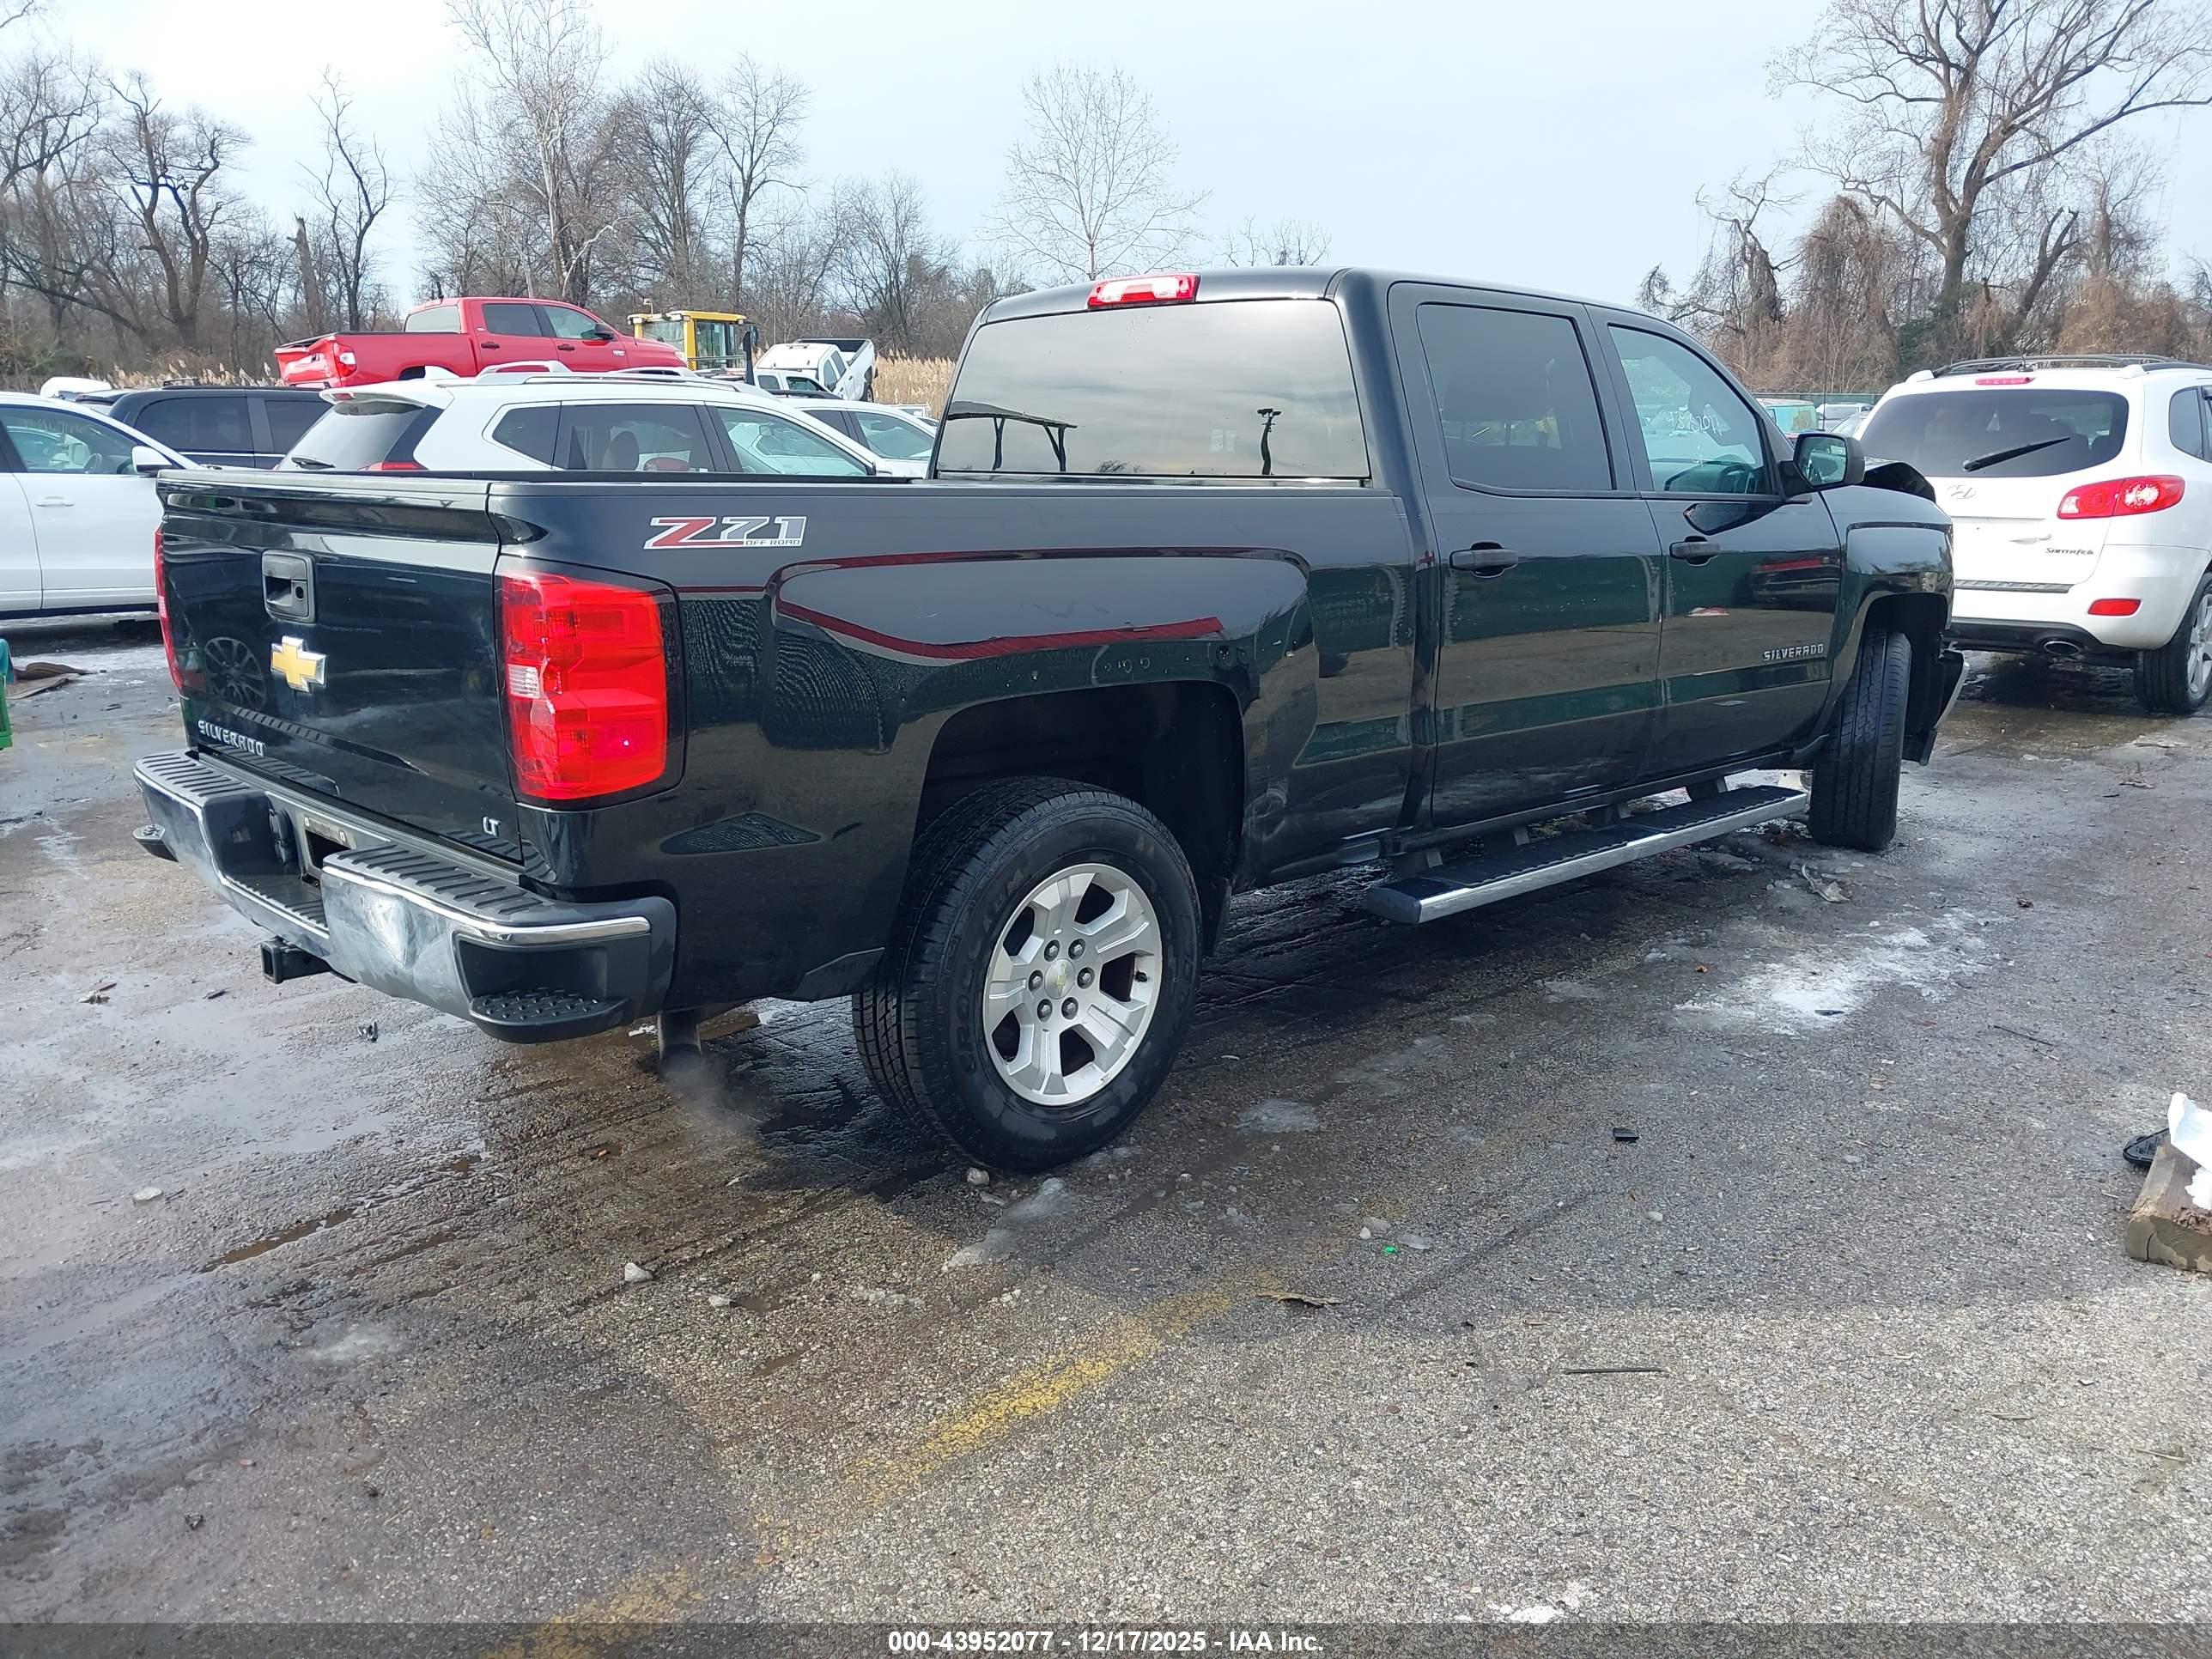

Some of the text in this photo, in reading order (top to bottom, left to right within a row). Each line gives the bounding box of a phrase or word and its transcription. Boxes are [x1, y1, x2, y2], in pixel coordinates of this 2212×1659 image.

[643, 516, 807, 550] Z71
[1762, 643, 1825, 661] SILVERADO
[198, 720, 266, 758] SILVERADO
[483, 817, 501, 838] LT
